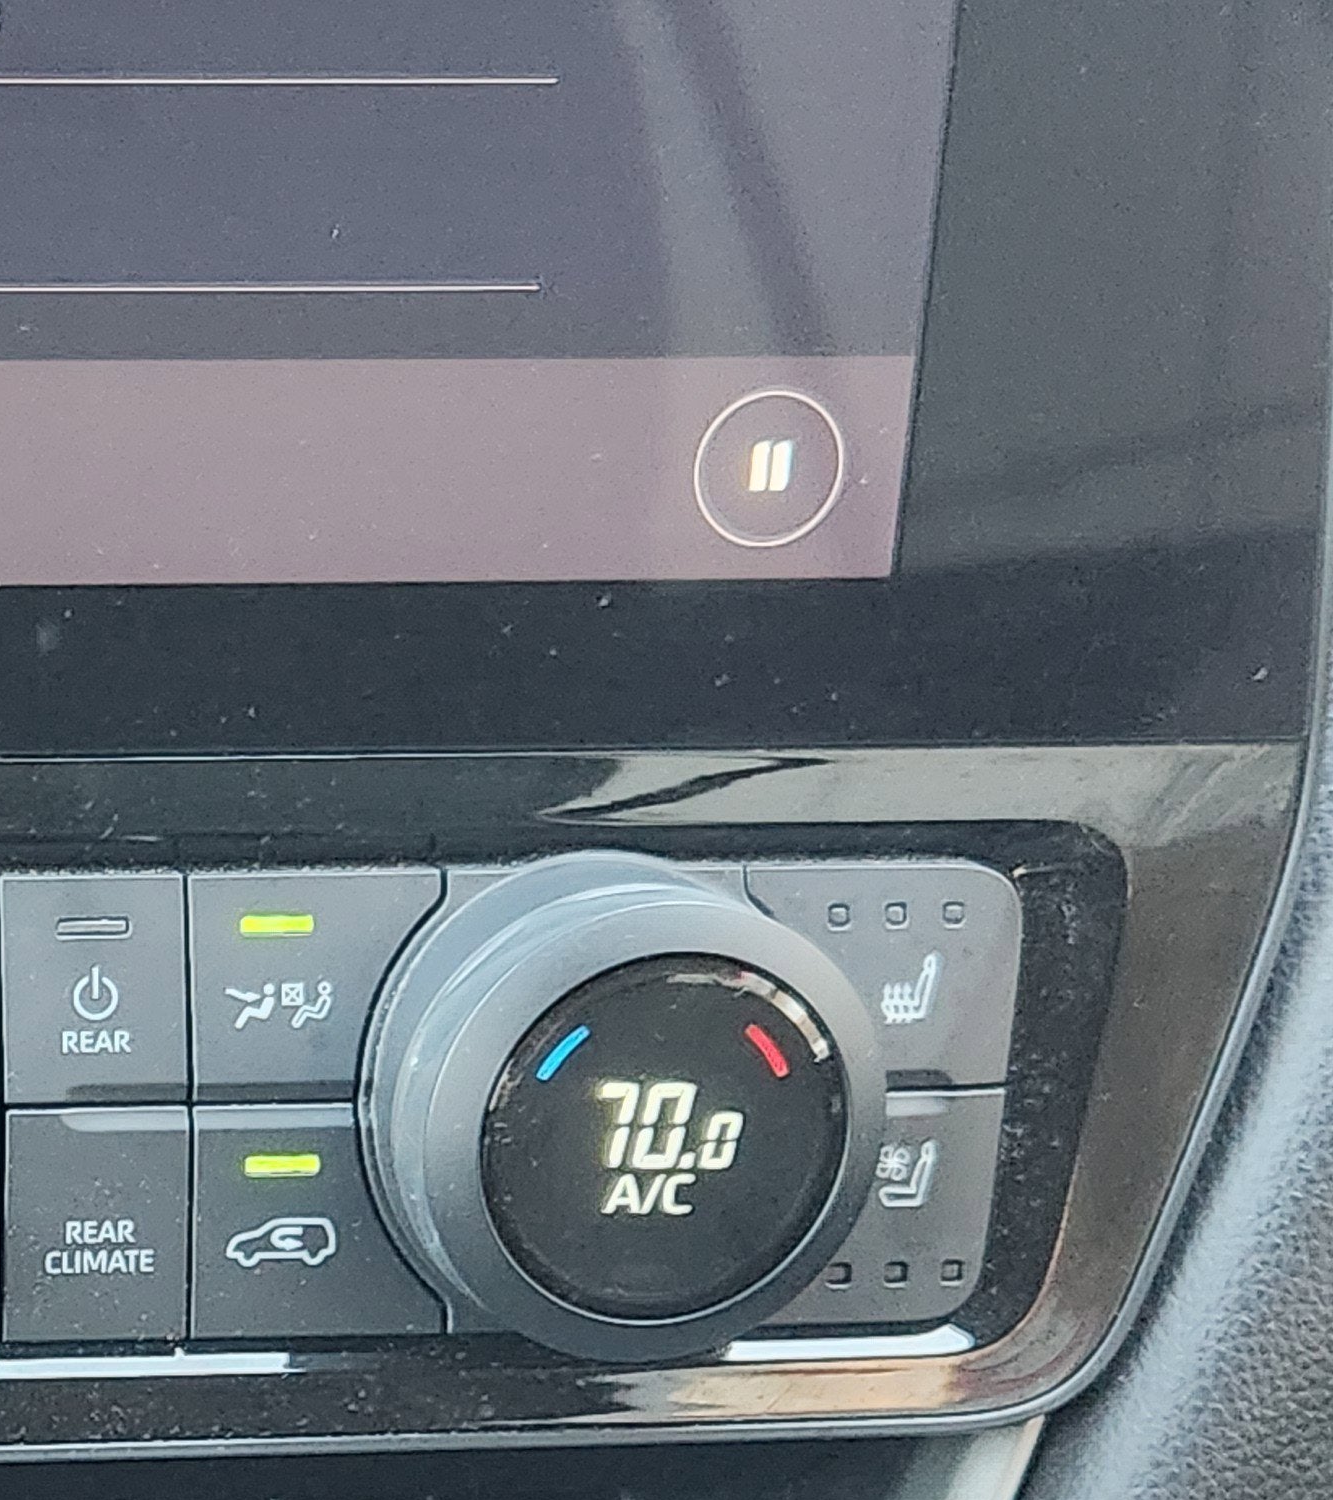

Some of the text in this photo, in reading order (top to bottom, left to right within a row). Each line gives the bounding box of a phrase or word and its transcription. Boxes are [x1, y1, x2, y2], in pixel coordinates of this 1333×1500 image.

[61, 1030, 132, 1054] REAR
[596, 1080, 745, 1171] 70.0
[599, 1173, 697, 1215] A/C
[64, 1219, 136, 1244] REAR
[44, 1249, 156, 1275] CLIMATE
